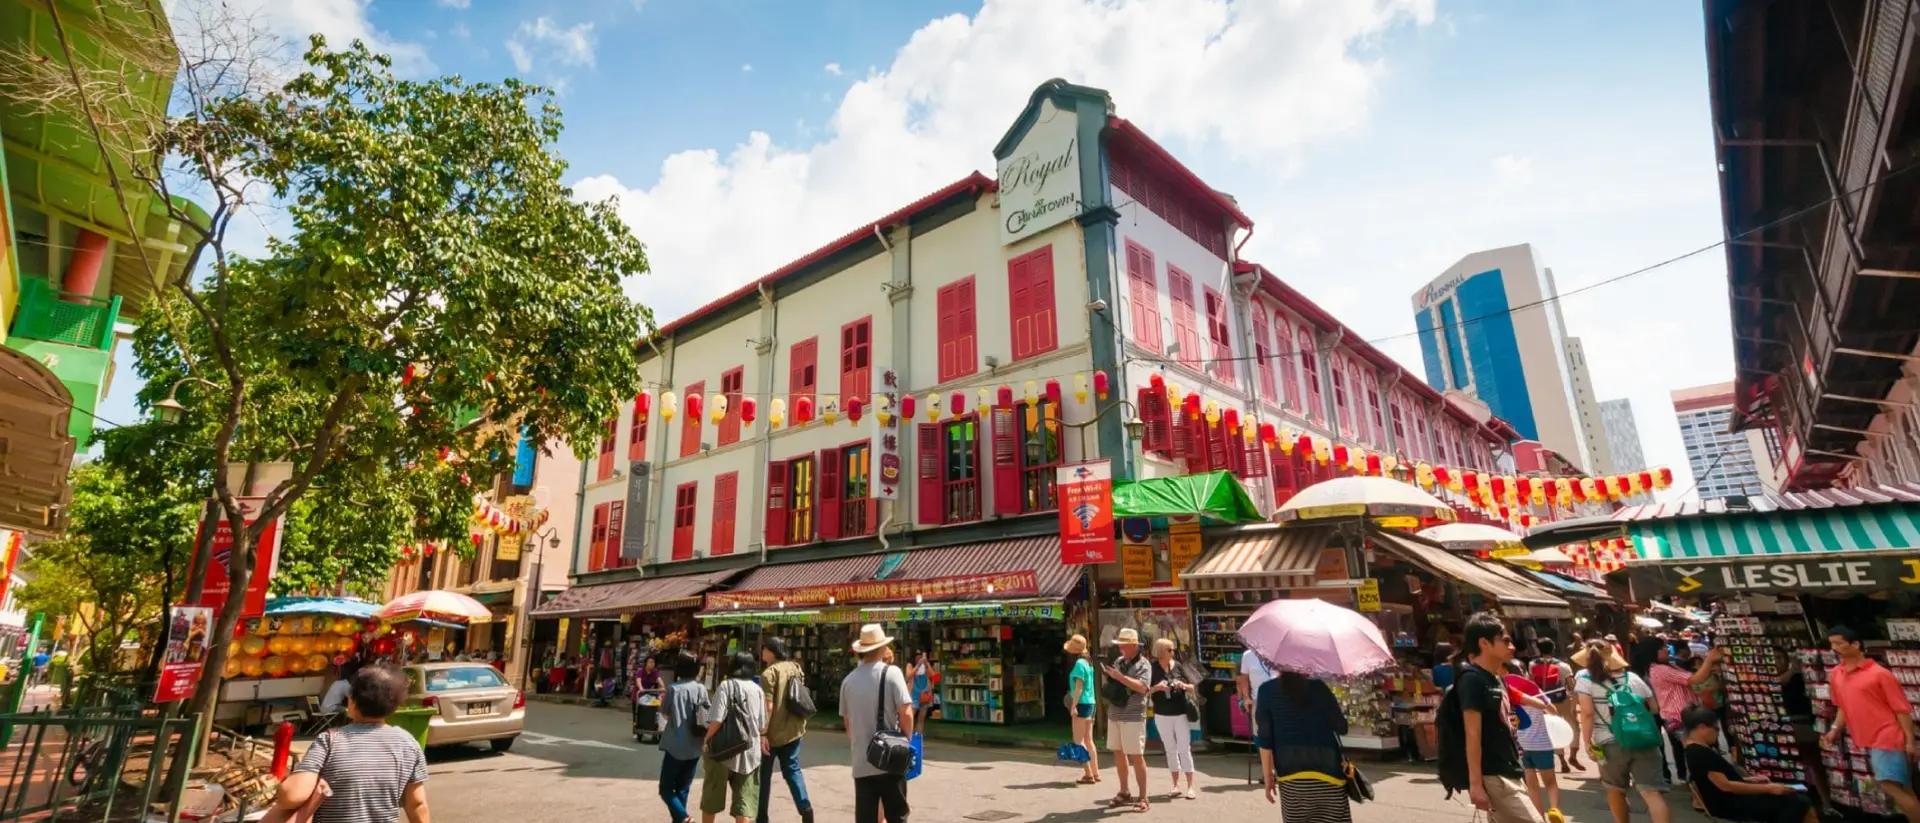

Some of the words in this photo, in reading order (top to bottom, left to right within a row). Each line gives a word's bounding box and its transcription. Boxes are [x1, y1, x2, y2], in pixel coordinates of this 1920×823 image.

[1001, 138, 1074, 196] Royal
[1067, 485, 1082, 494] Free
[1720, 561, 1877, 589] LESLIE
